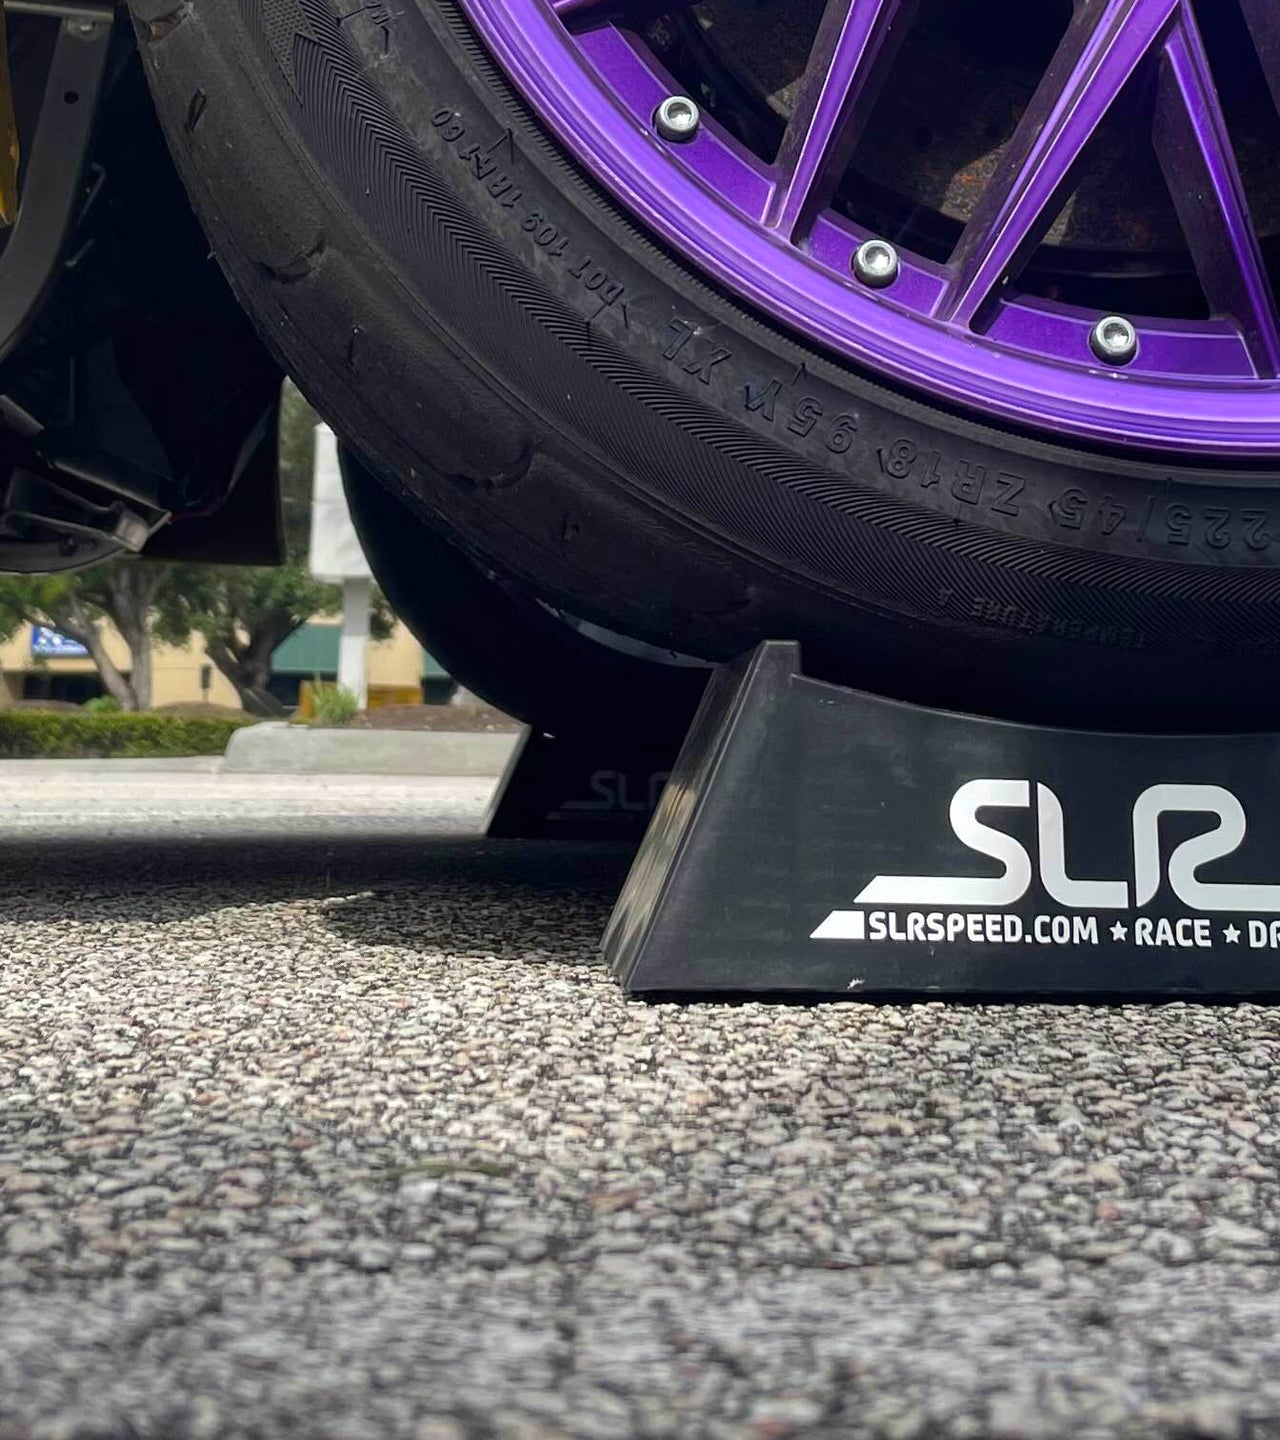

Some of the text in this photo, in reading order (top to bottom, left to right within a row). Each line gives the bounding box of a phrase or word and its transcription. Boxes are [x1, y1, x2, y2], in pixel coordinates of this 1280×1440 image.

[565, 252, 628, 309] DOT
[664, 313, 730, 386] XL
[880, 434, 1026, 519] ZR18
[1046, 484, 1272, 551] 225/45
[970, 594, 1148, 650] TEMPERATURE
[868, 912, 1099, 946] SLRSPEED.COM
[1134, 917, 1212, 948] RACE
